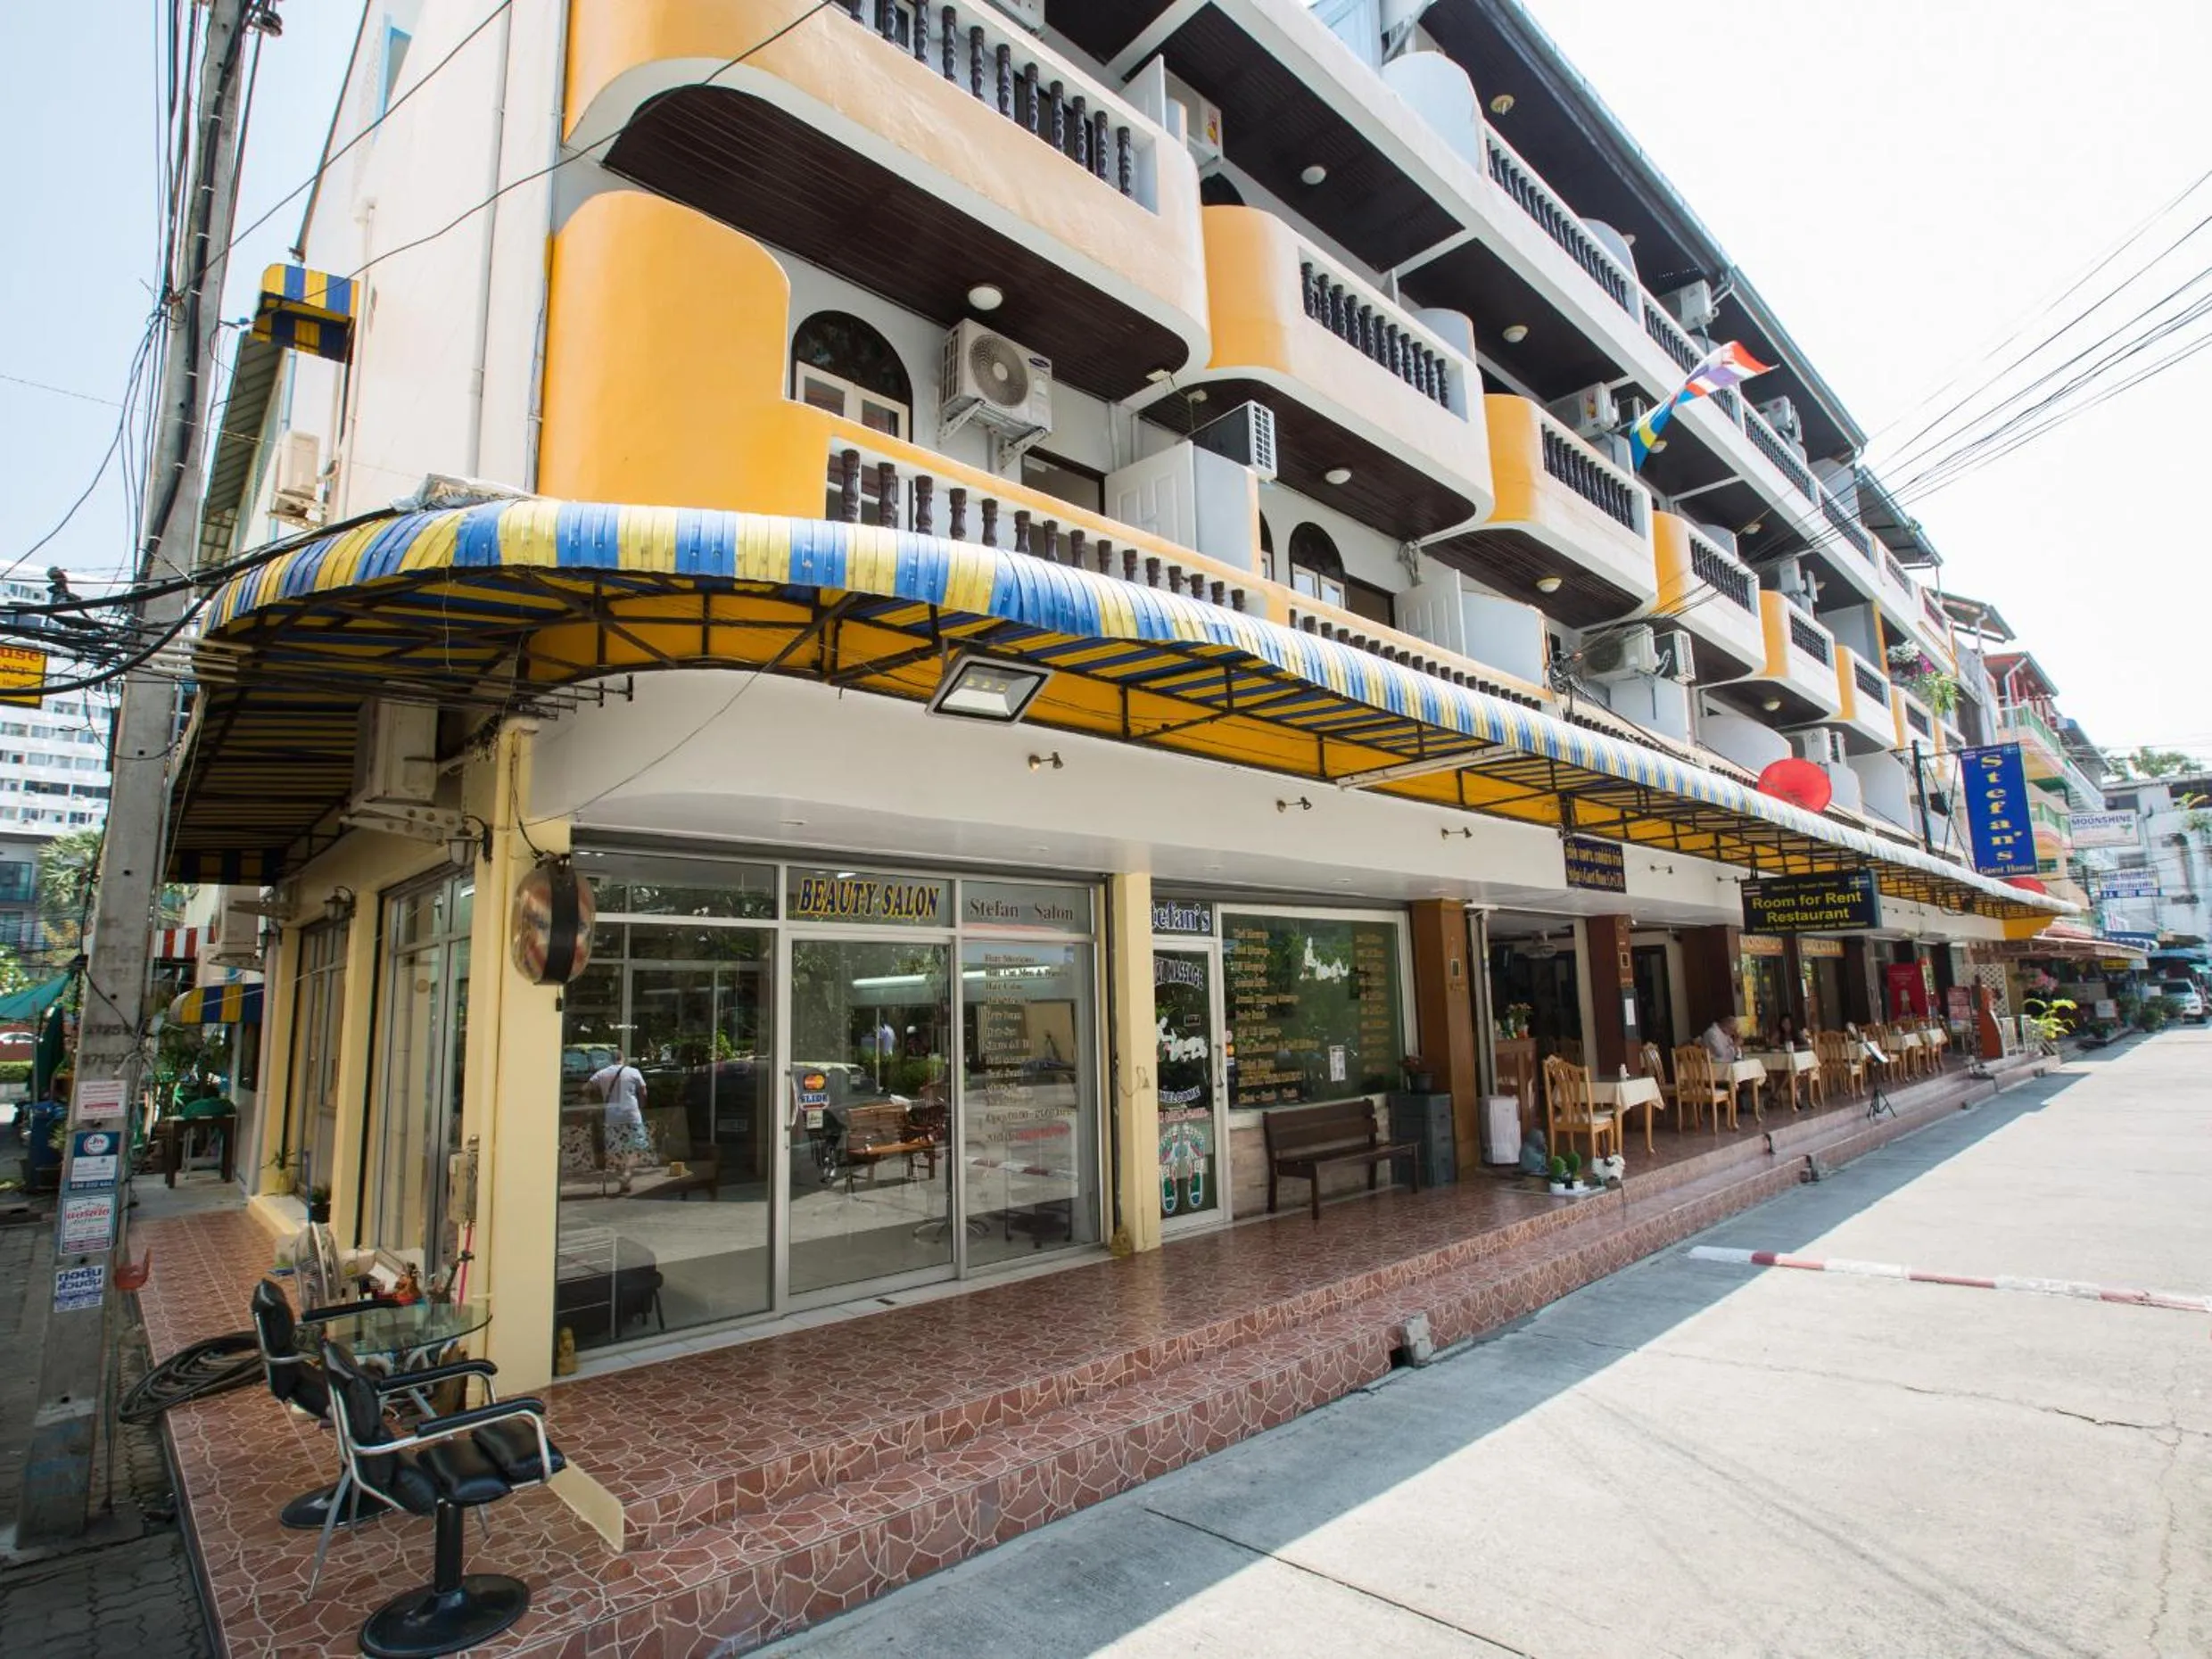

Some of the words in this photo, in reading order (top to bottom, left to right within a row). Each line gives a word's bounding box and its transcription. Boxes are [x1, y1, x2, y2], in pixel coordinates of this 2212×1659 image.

[2071, 814, 2133, 826] MOONSHINE
[798, 877, 878, 914] BEAUTY
[880, 883, 940, 918] SALON
[1752, 897, 1795, 909] Room
[1799, 894, 1821, 906] for
[1825, 891, 1862, 904] Rent
[970, 898, 1019, 919] Stefan
[1035, 901, 1074, 921] Salon
[1151, 900, 1210, 932] tefan's
[1766, 908, 1850, 923] Restaurant
